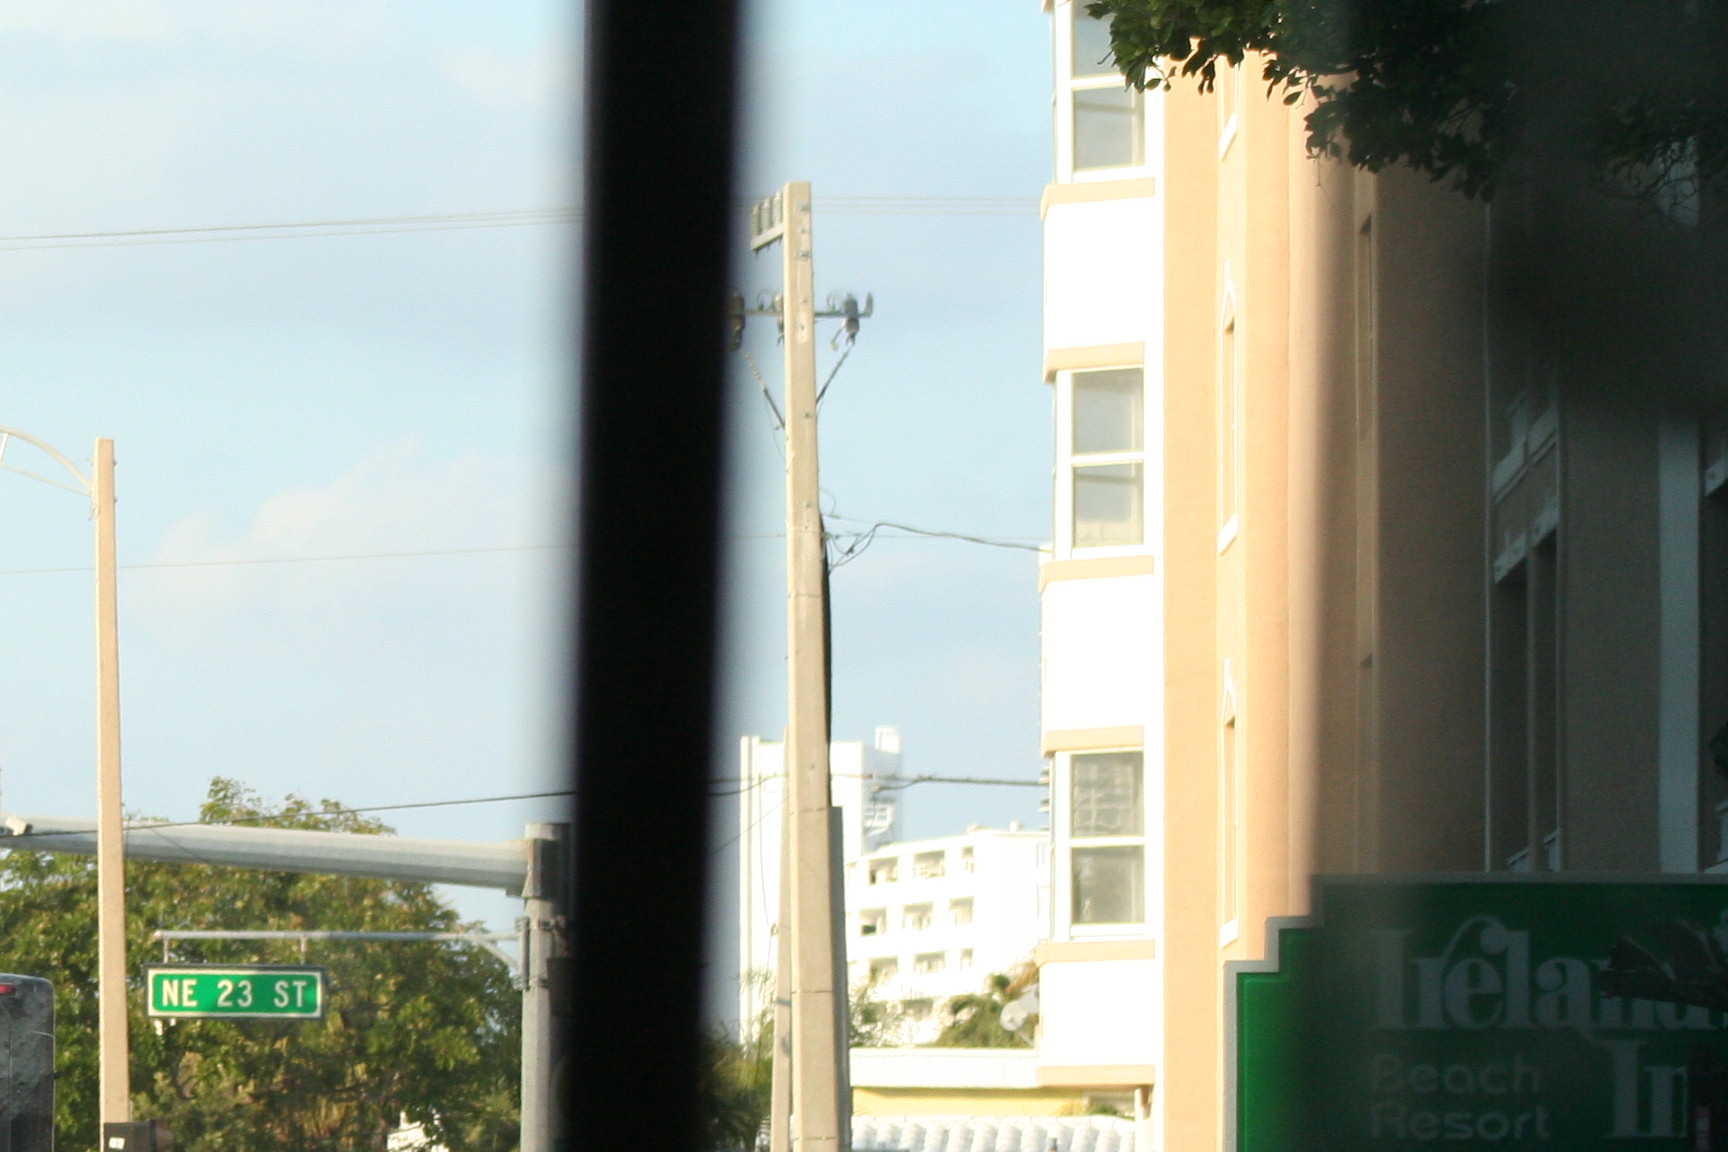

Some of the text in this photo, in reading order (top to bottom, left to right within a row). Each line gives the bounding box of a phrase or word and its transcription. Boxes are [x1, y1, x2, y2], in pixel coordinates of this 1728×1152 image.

[162, 979, 307, 1008] NE 23 ST
[1371, 1053, 1542, 1095] Beach
[1371, 1104, 1550, 1141] Resort
